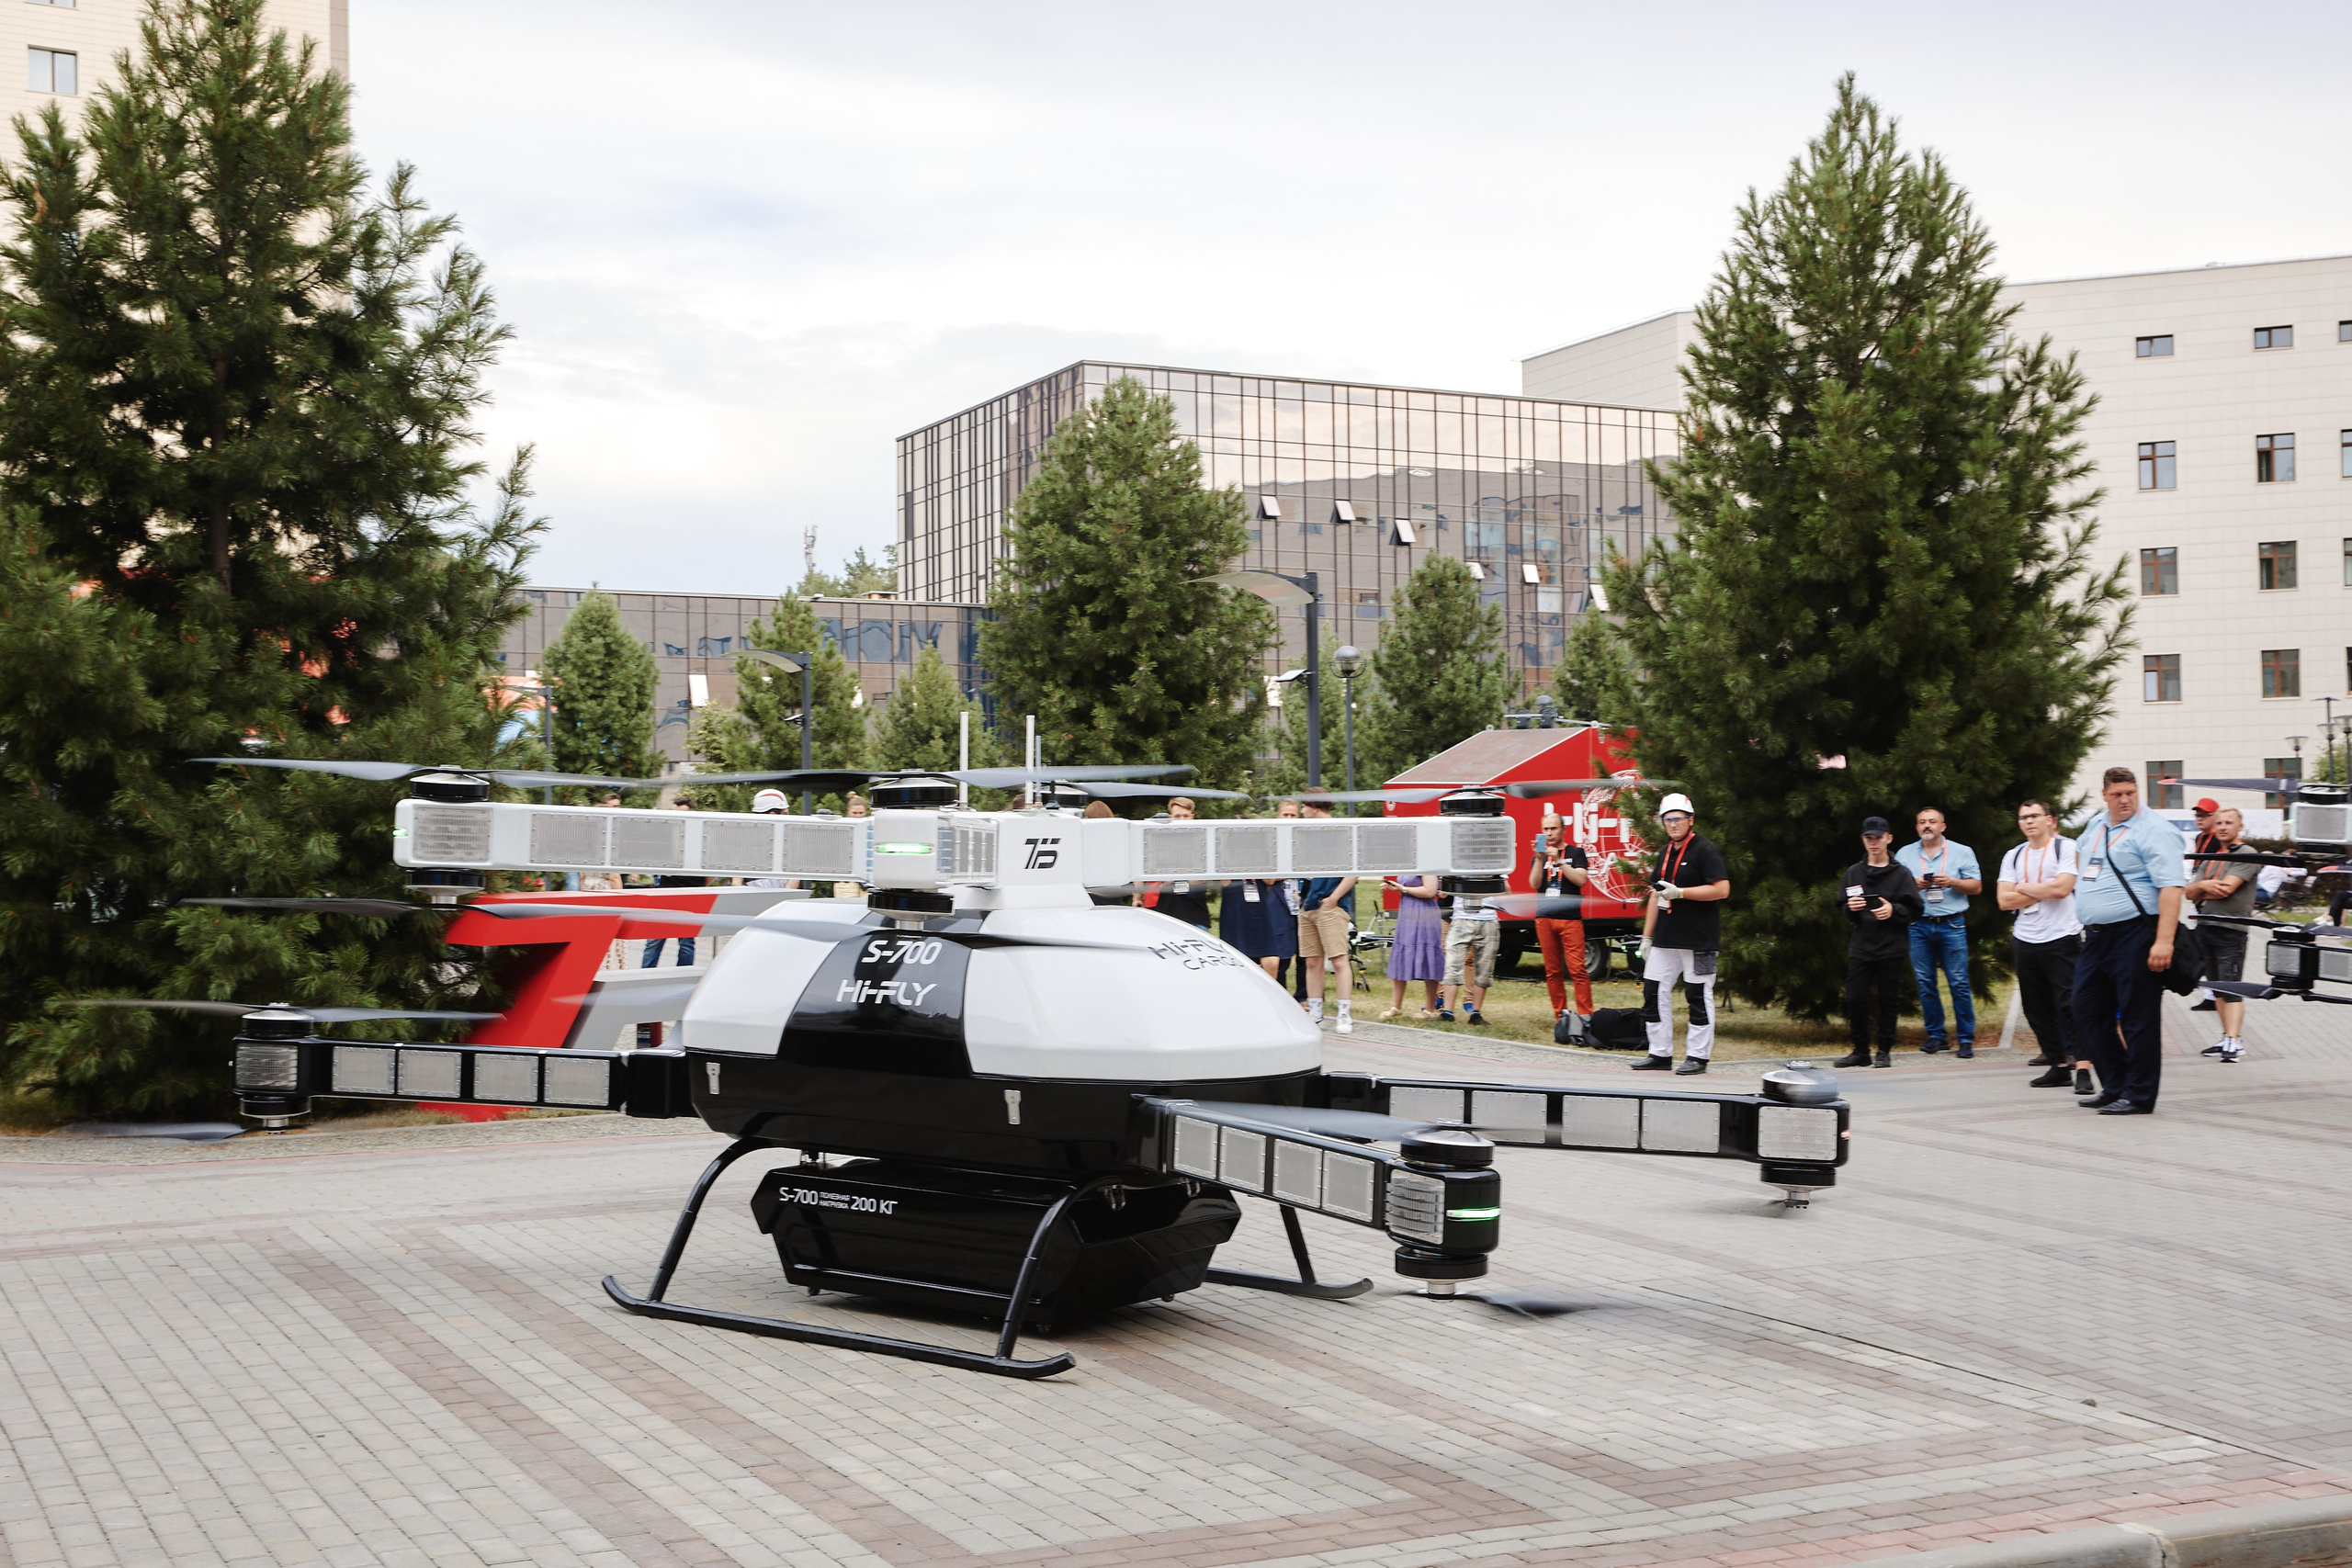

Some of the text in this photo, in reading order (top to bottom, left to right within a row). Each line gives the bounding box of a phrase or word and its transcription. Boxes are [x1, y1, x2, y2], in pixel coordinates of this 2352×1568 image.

[861, 940, 943, 965] S-700
[835, 979, 938, 1007] Hi-FLY
[779, 1187, 819, 1205] S-700
[850, 1196, 899, 1214] 200 КГ
